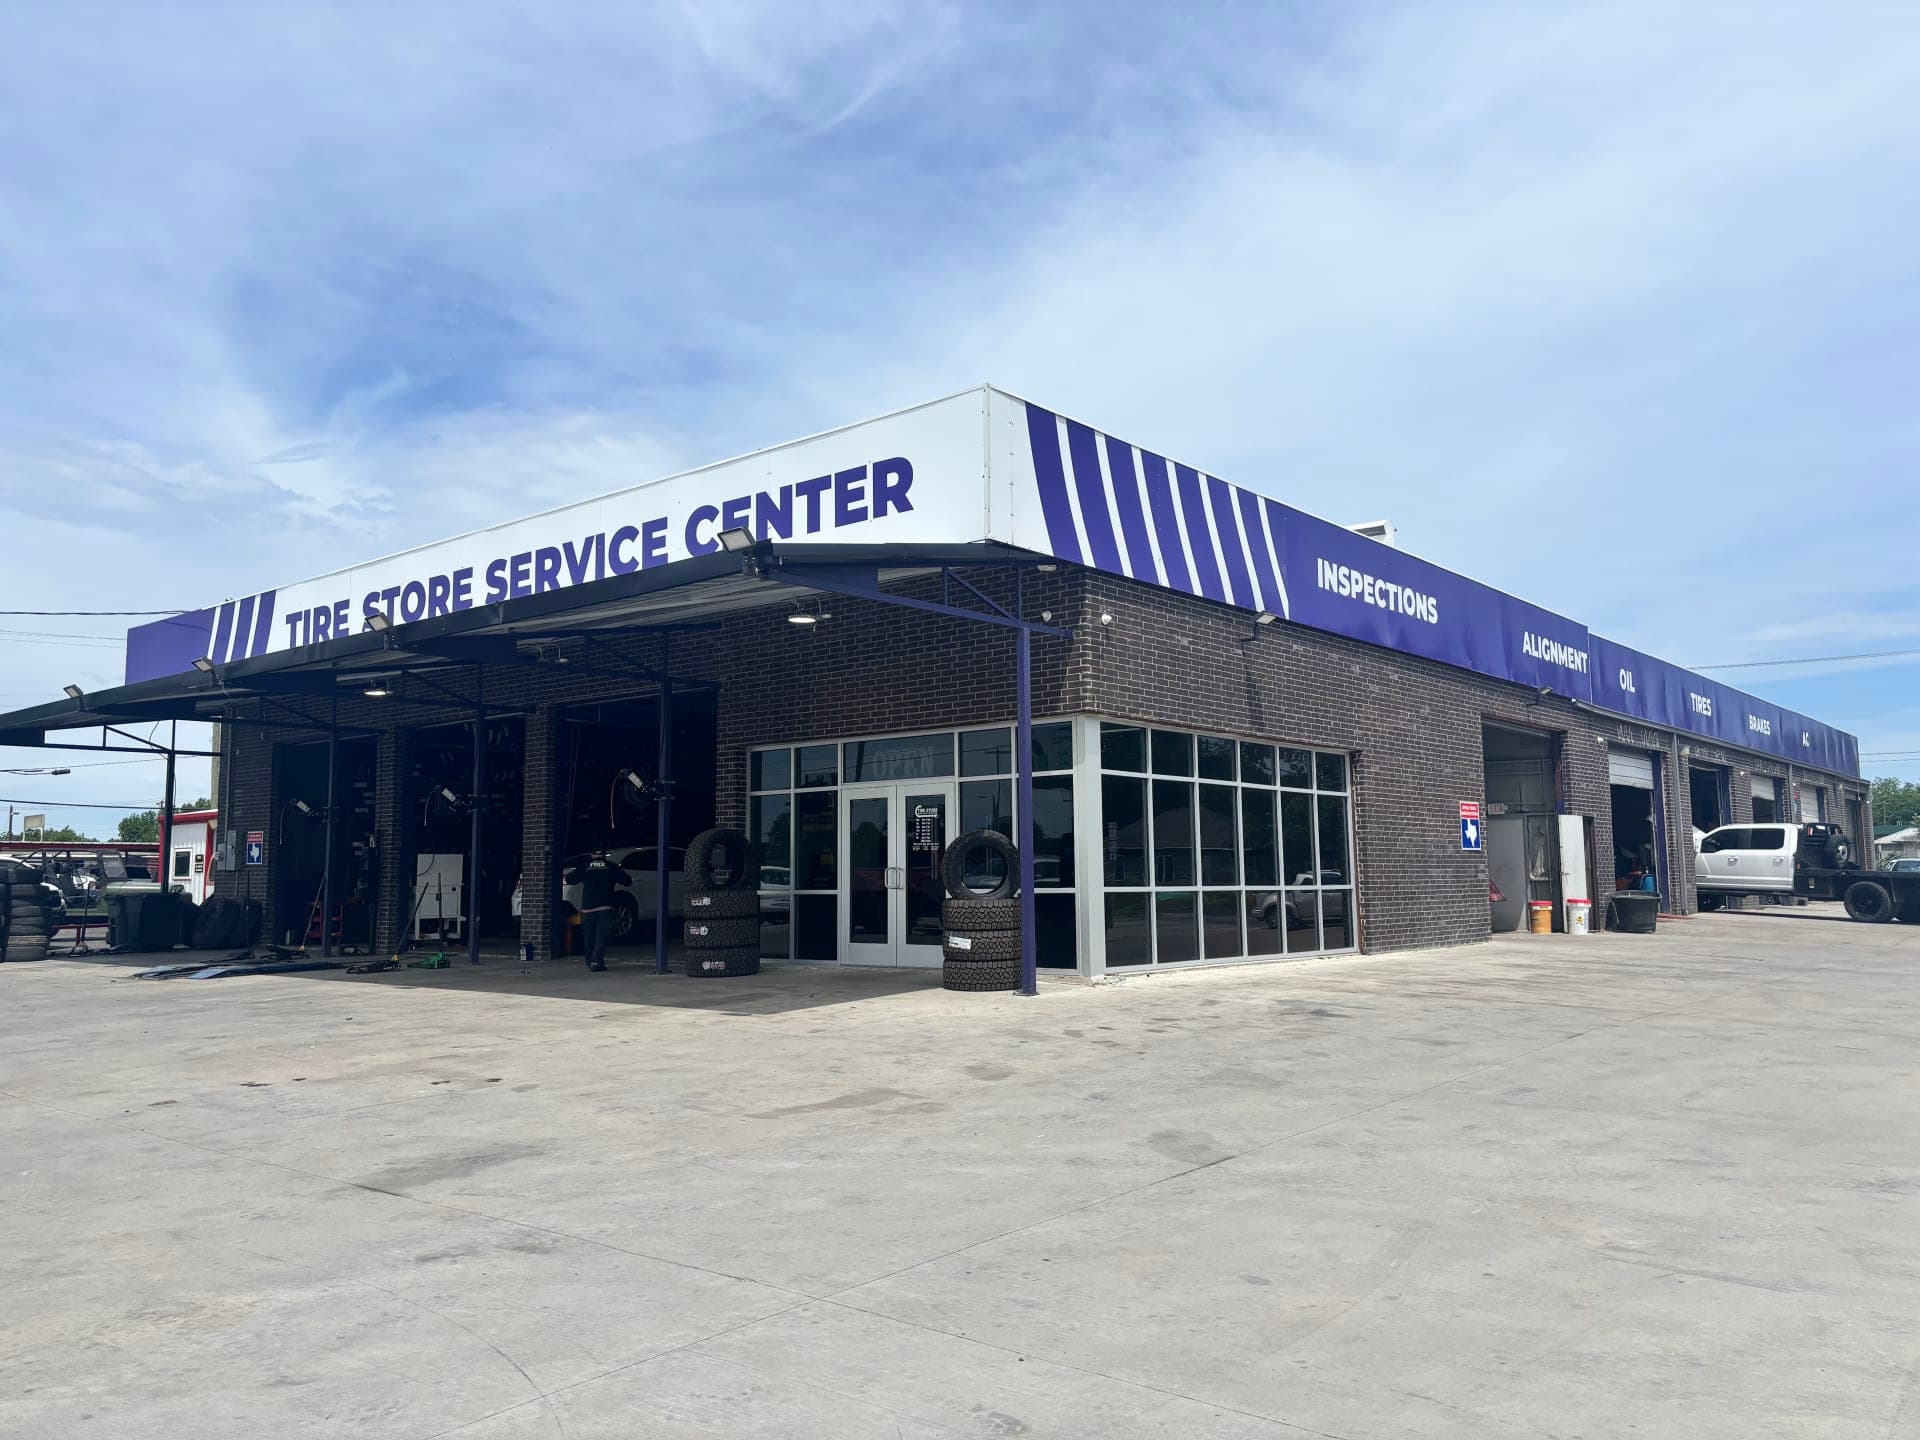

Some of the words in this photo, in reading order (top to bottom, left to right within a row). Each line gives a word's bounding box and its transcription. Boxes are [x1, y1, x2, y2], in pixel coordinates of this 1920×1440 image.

[286, 599, 350, 649] TIRE
[362, 566, 473, 632] STORE
[485, 516, 668, 605] SERVICE
[685, 456, 914, 557] CENTER
[1317, 557, 1438, 624] INSPECTIONS
[1522, 630, 1588, 674] ALIGNMENT
[1619, 668, 1636, 693] OIL
[1690, 692, 1712, 717] TIRES
[1748, 714, 1771, 736] BRAKES
[1802, 731, 1810, 747] AC
